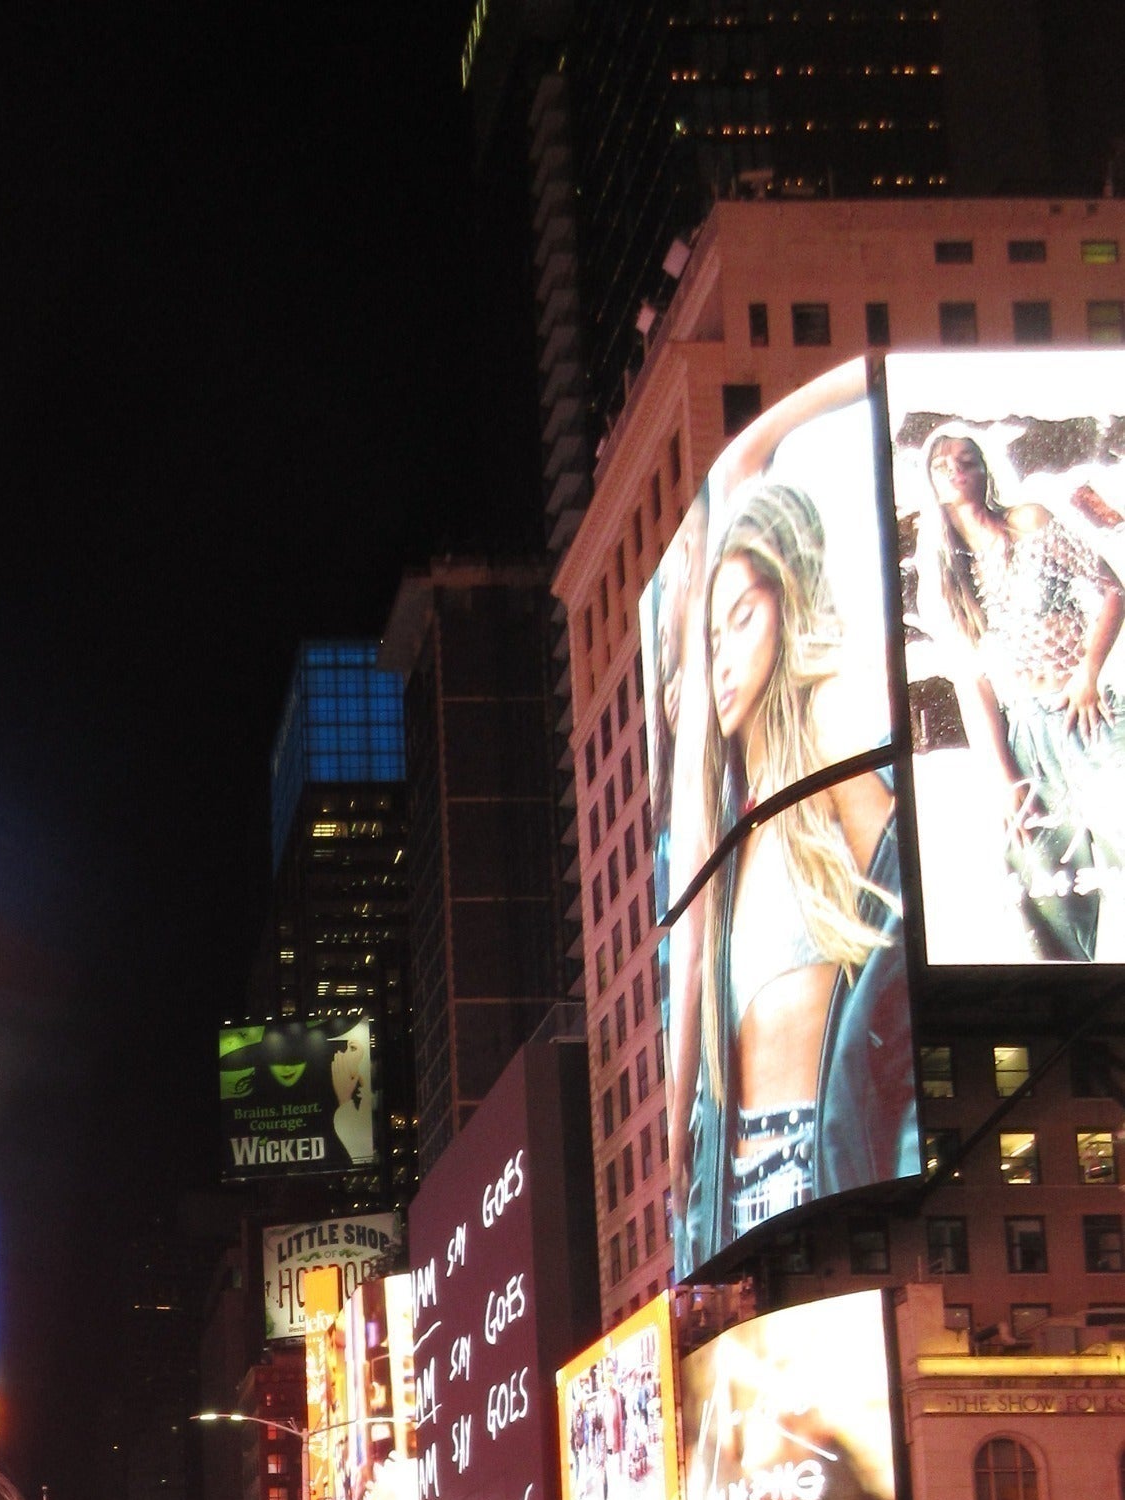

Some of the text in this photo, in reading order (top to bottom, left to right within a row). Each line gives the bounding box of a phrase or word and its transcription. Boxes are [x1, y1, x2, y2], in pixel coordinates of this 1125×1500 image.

[234, 1102, 323, 1120] Brains. Heart.
[249, 1118, 308, 1132] Courage.
[482, 1149, 523, 1229] GOES
[277, 1224, 392, 1264] LITTLE SHOP
[323, 1250, 337, 1259] OF
[485, 1272, 525, 1345] GOES
[487, 1366, 528, 1441] GOES
[954, 1395, 991, 1412] THE
[998, 1394, 1055, 1412] SHOW
